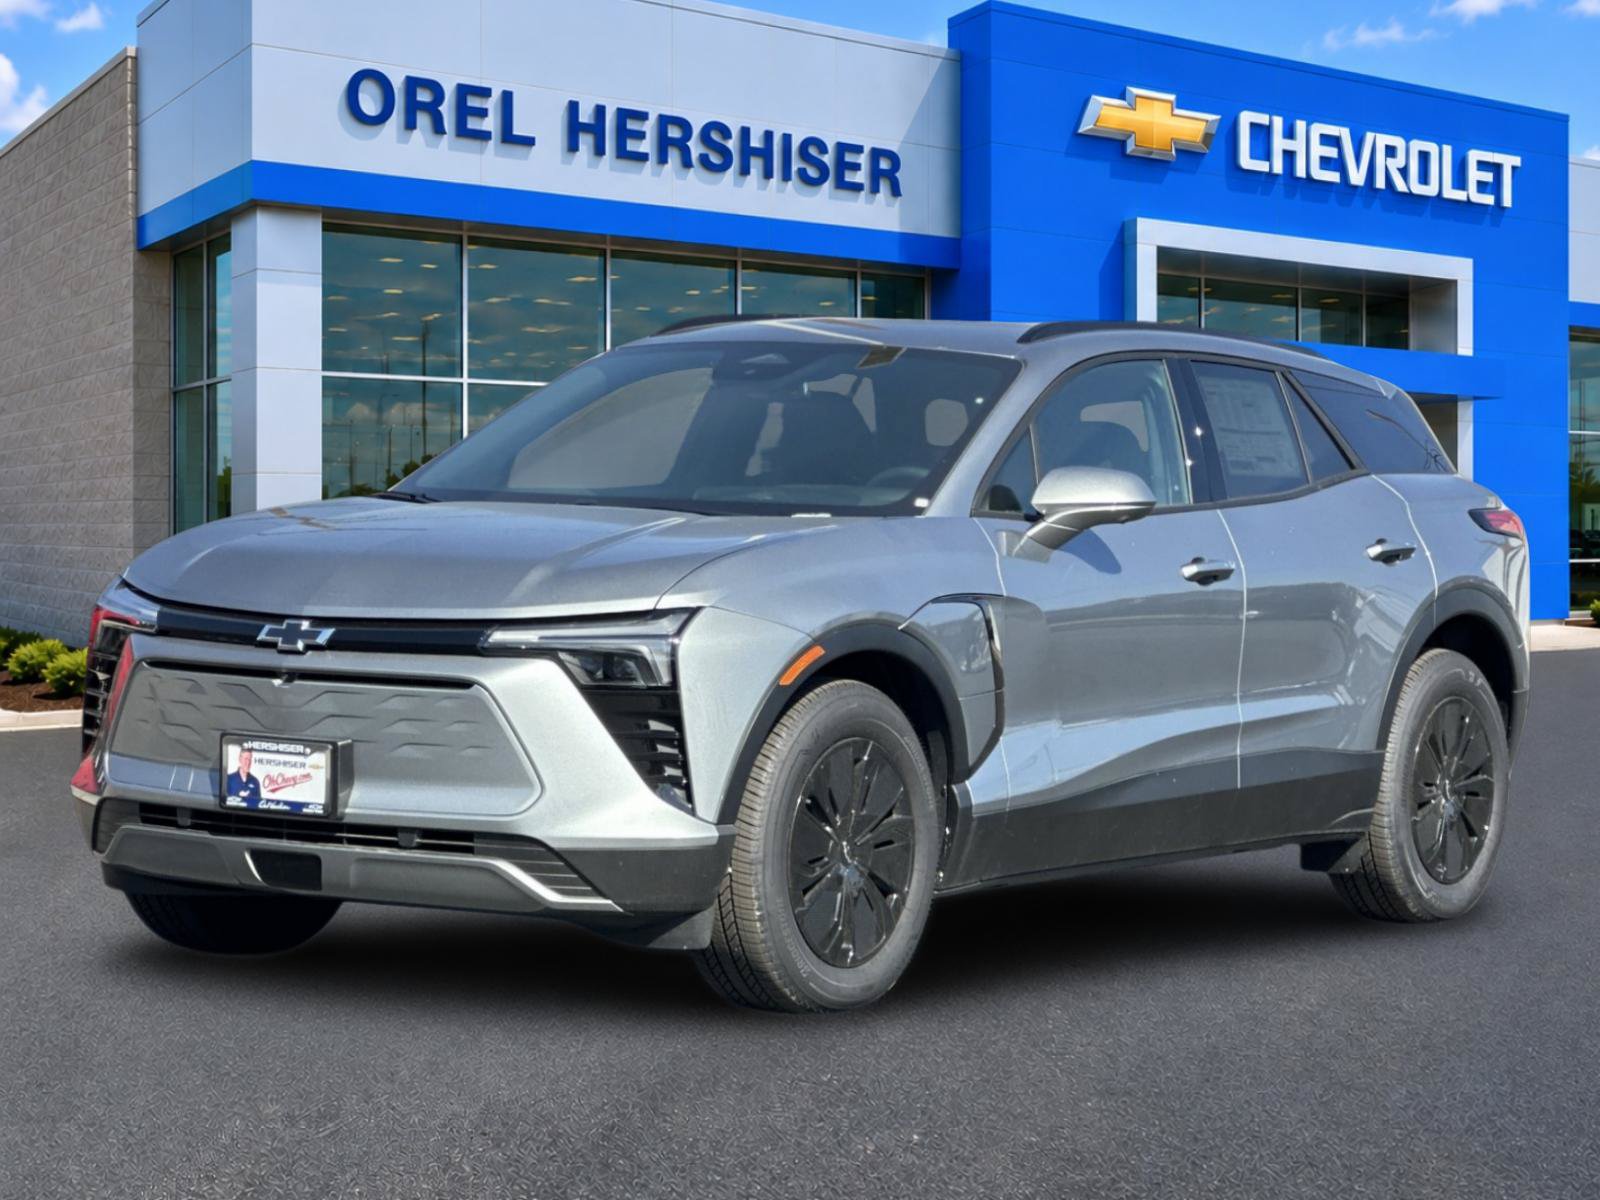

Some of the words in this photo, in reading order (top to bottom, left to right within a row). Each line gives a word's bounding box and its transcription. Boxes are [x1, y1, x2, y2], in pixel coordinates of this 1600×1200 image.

[347, 68, 536, 146] OREL
[567, 99, 902, 197] HERSHISER
[1237, 109, 1522, 208] CHEVROLET
[247, 741, 304, 753] HERSHISER
[254, 757, 306, 769] HERSHISER
